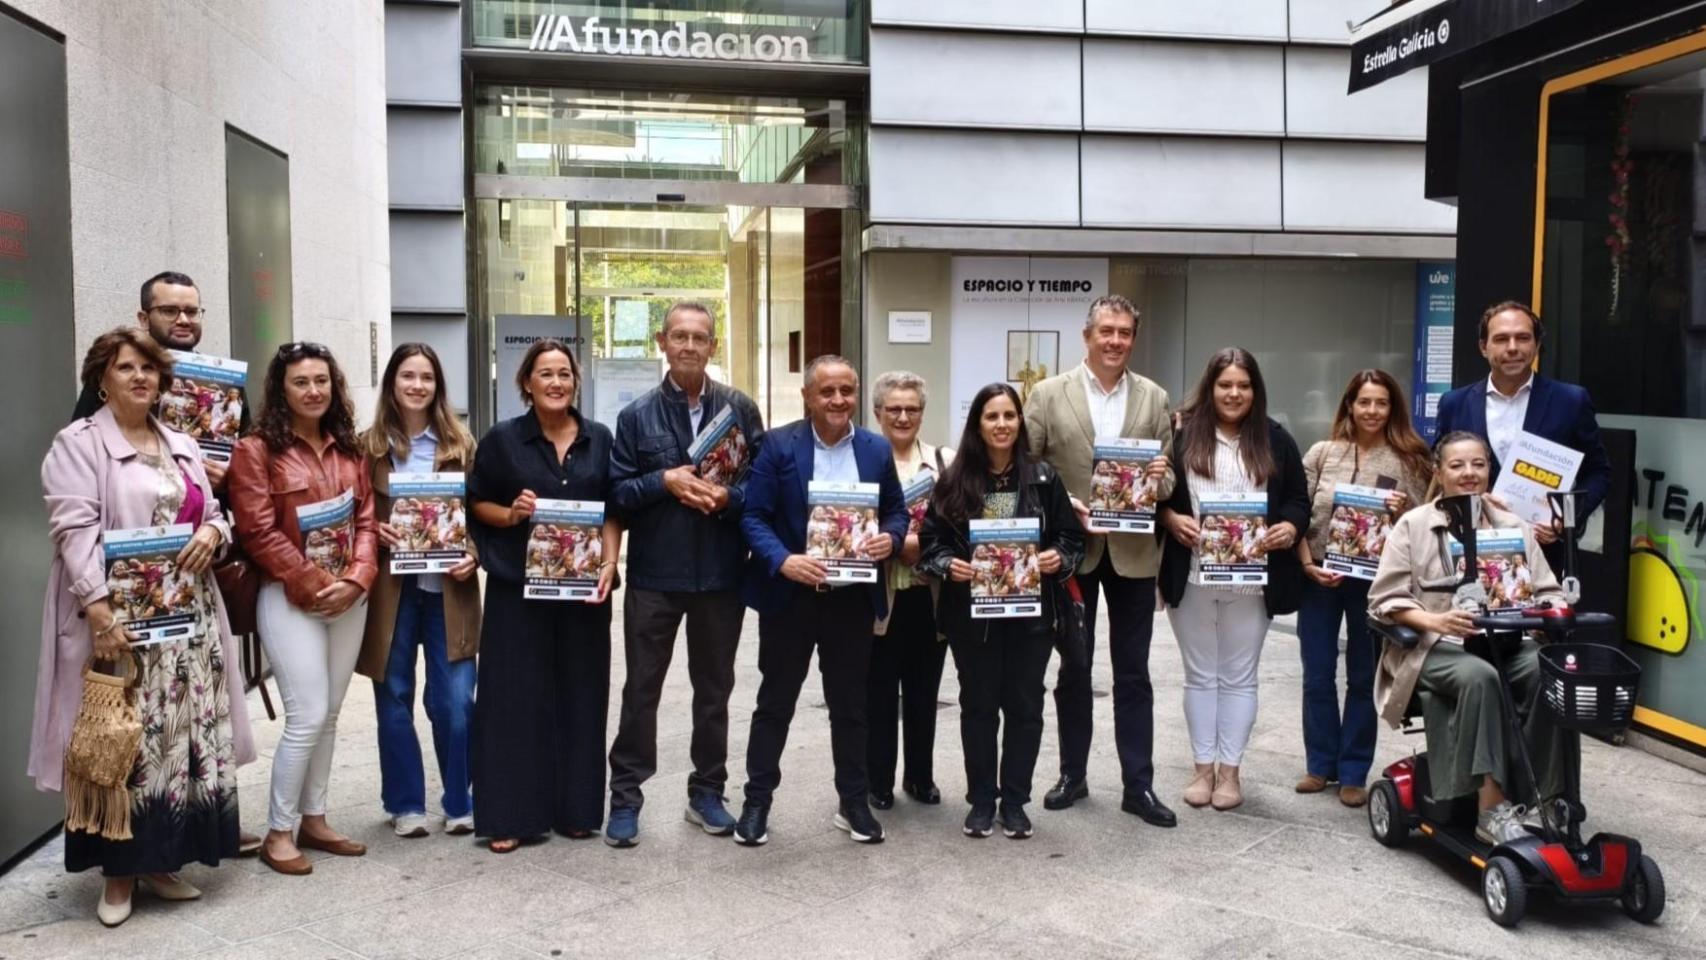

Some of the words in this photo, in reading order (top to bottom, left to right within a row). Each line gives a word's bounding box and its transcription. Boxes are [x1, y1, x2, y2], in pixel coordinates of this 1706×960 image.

[1362, 44, 1397, 73] Estrella
[1399, 28, 1435, 58] Galicia
[963, 280, 1023, 292] ESPACIO
[1027, 280, 1036, 292] Y
[1039, 280, 1092, 292] TIEMPO
[1515, 462, 1561, 486] GADIS
